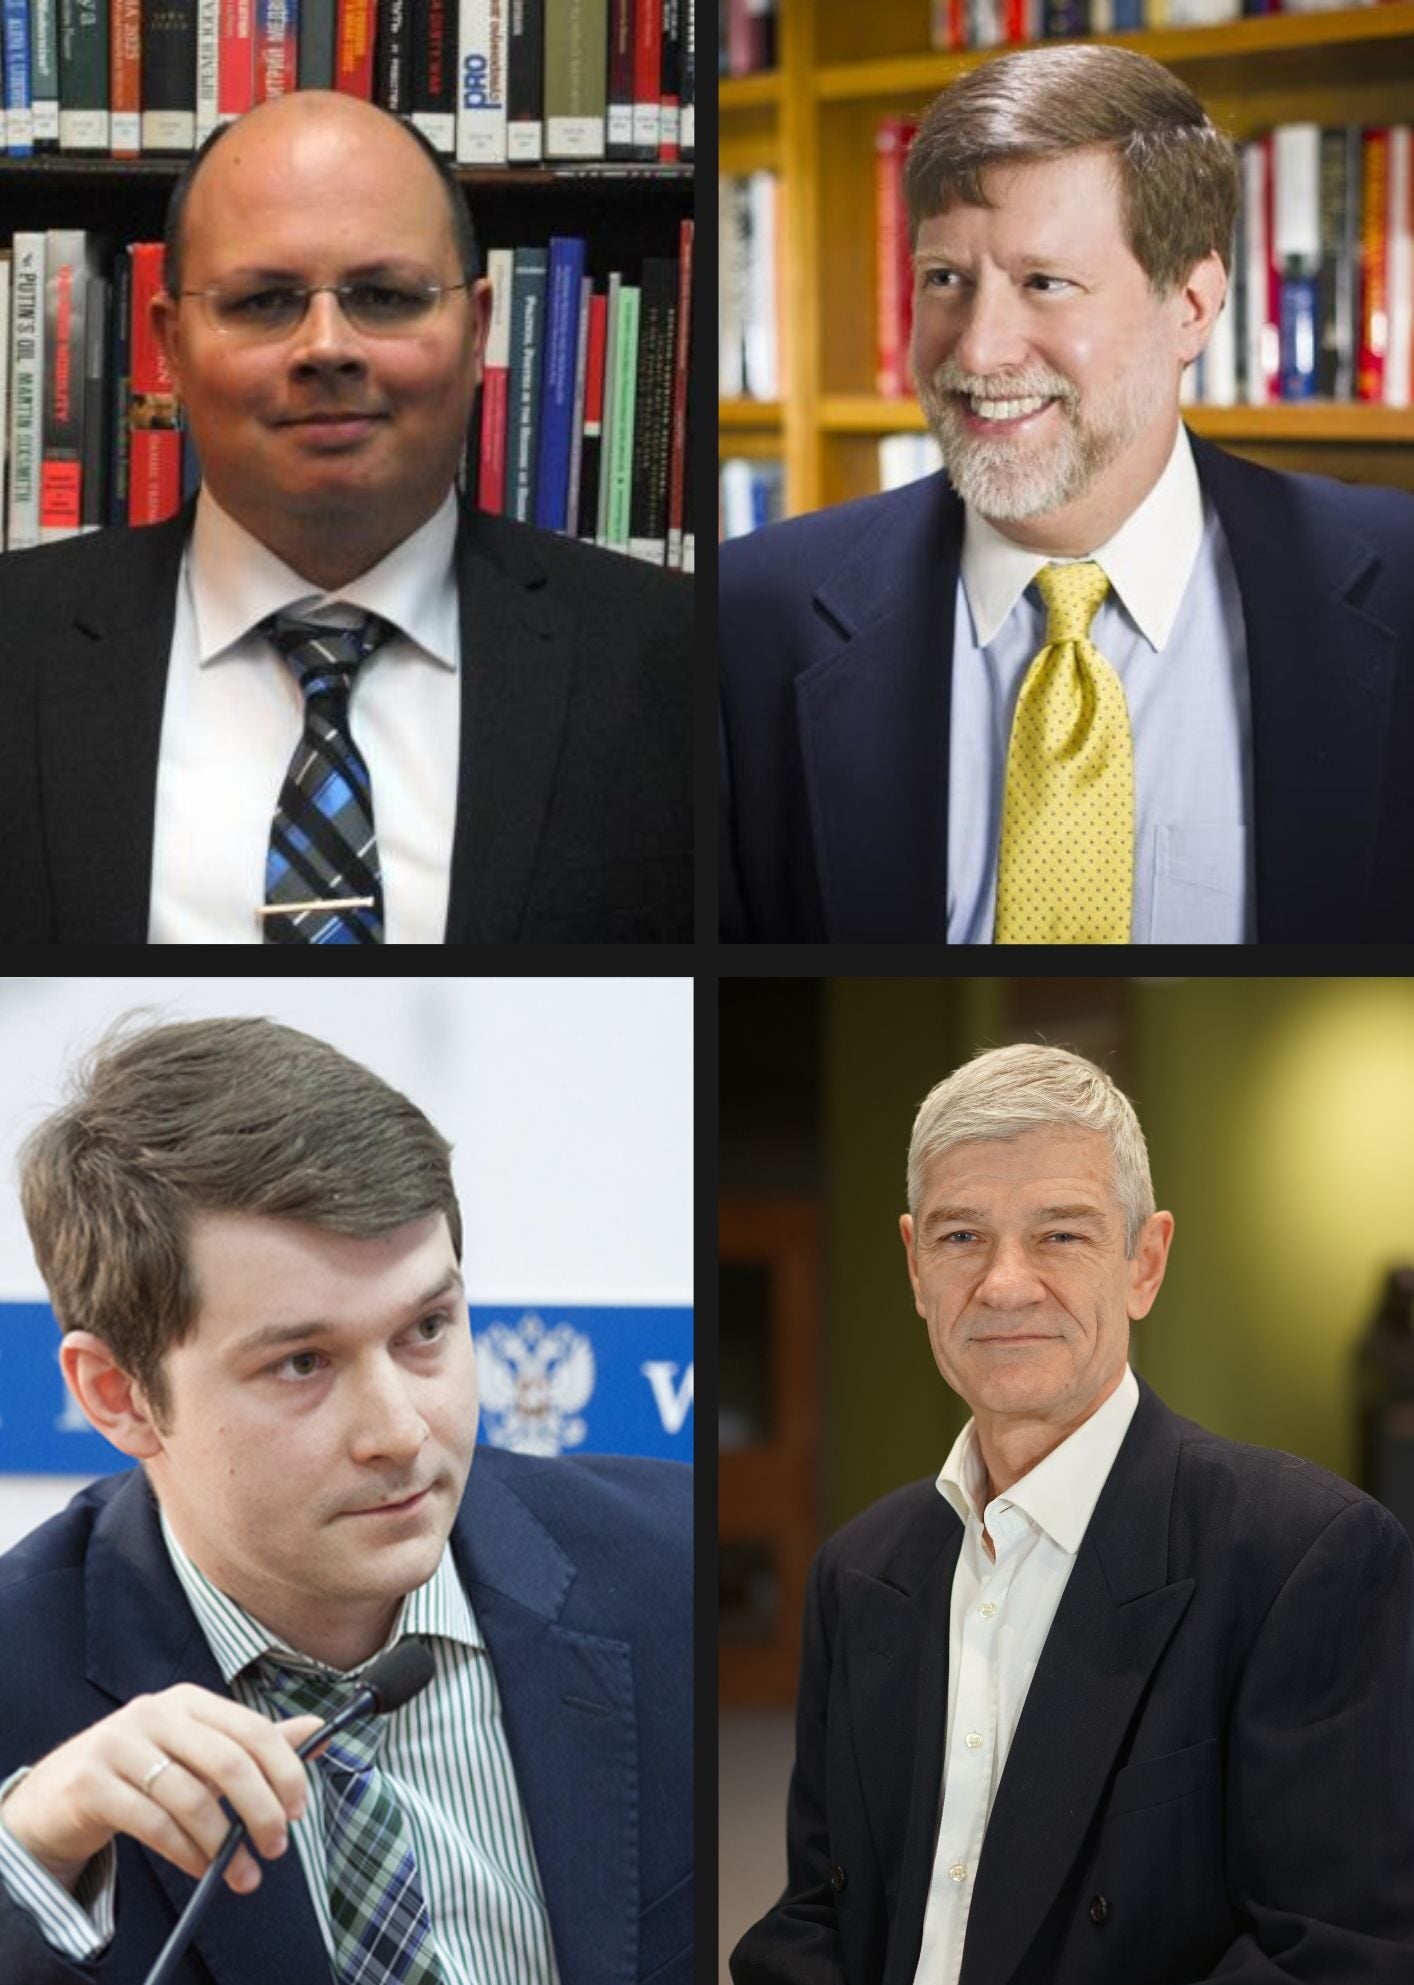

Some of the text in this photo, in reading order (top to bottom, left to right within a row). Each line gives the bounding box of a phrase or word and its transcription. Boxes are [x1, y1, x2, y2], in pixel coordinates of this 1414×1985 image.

[17, 273, 37, 334] PUTIN'S
[17, 340, 35, 362] OIL
[17, 373, 33, 428] MARTIN
